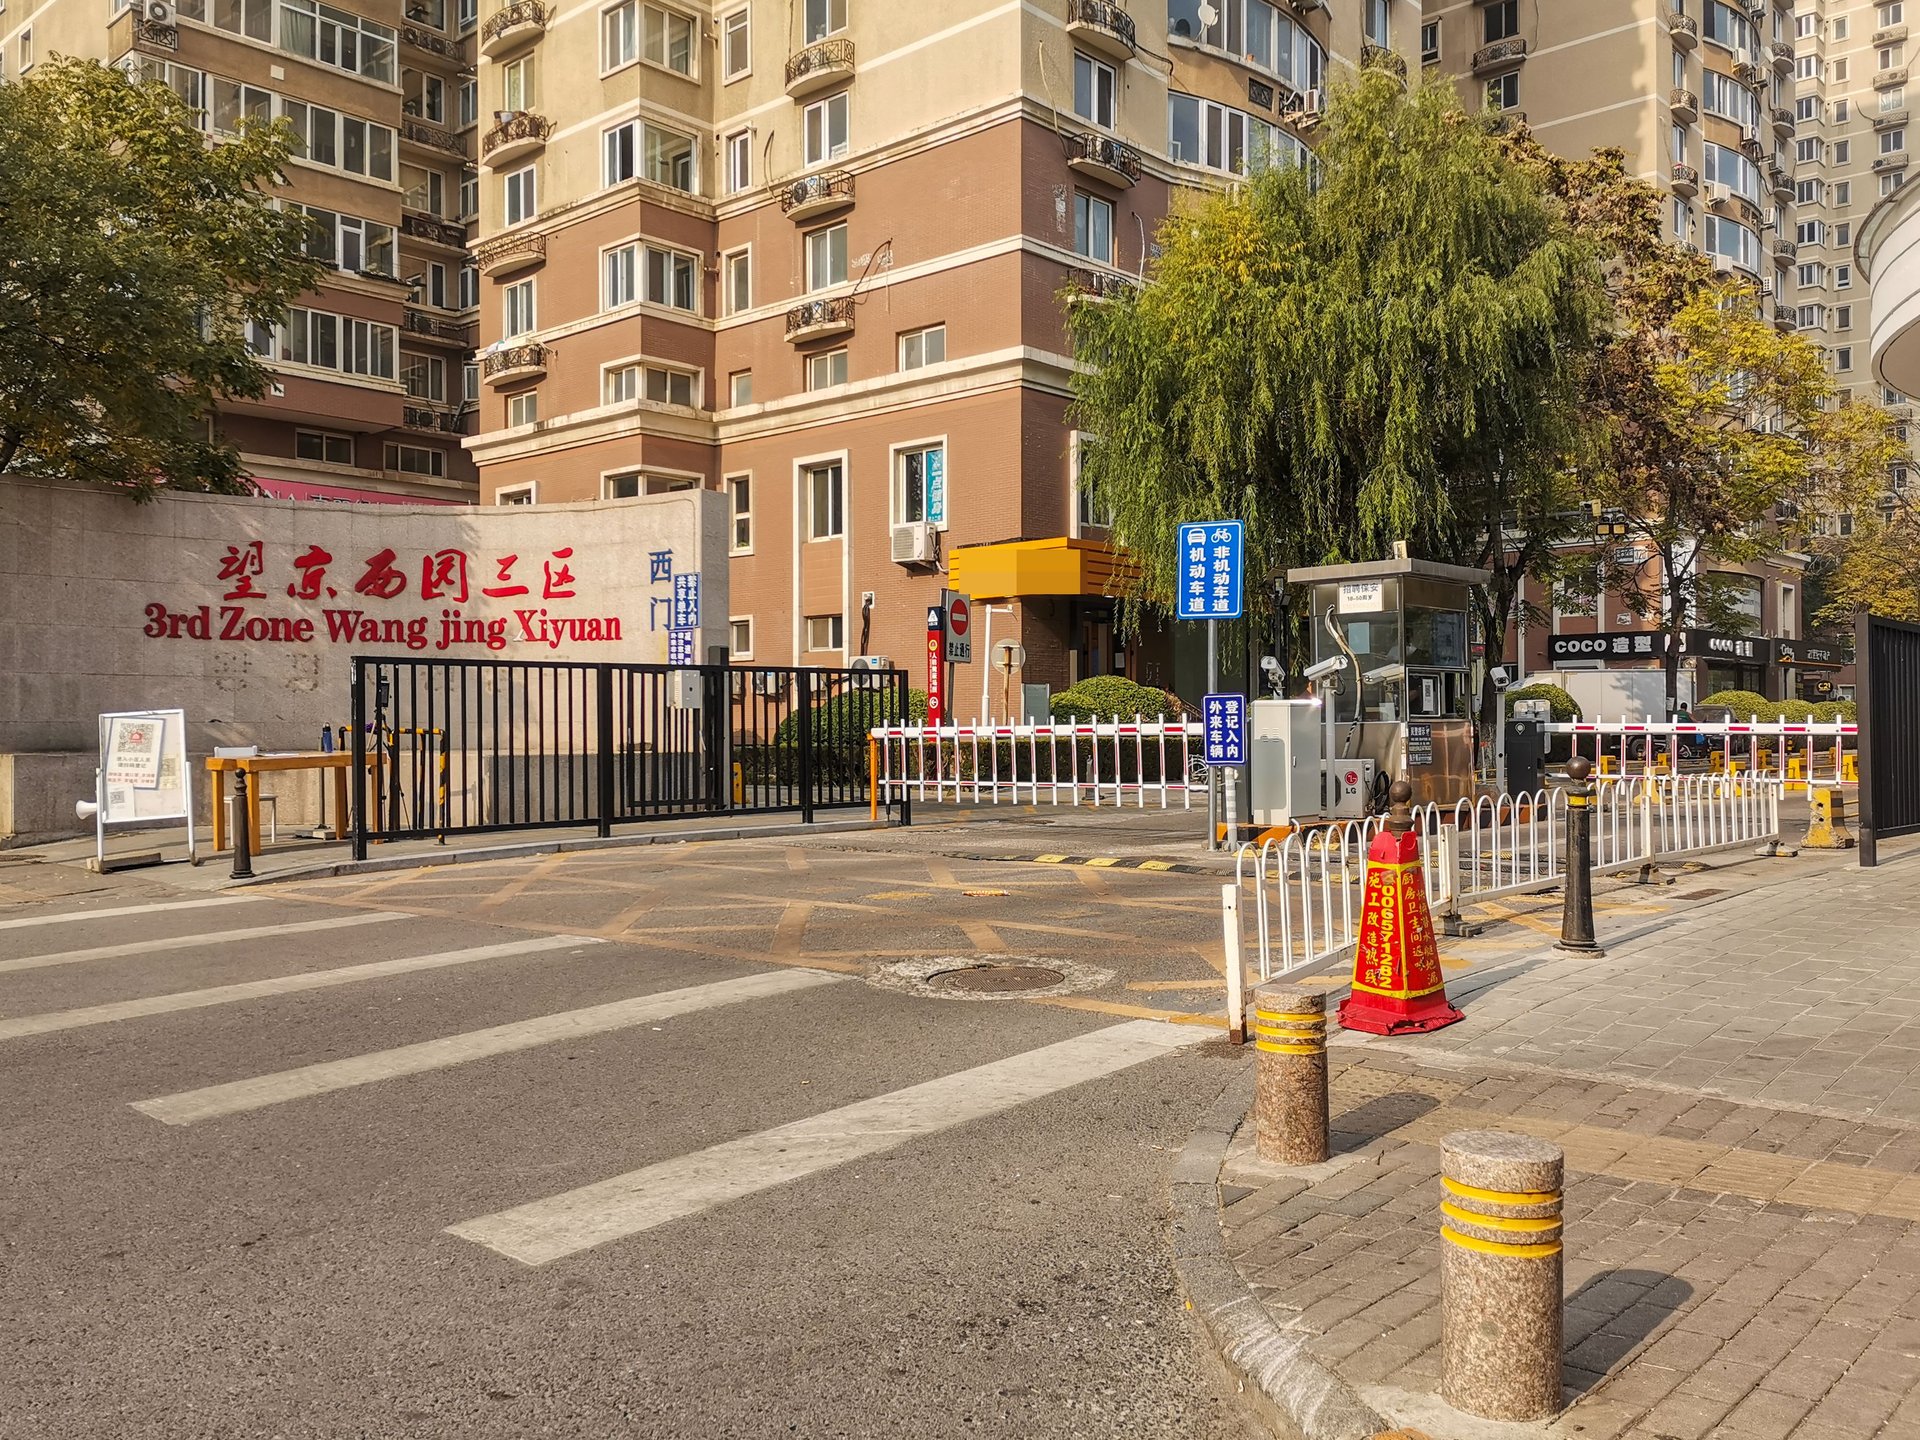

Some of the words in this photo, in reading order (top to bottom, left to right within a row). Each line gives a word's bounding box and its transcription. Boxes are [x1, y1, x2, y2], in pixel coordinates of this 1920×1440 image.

[217, 541, 577, 602] 望京西园三区
[648, 548, 674, 632] 西门
[1188, 547, 1206, 612] 机动车道
[1212, 546, 1231, 612] 非机动车道
[1343, 583, 1378, 594] 招聘保安
[143, 603, 211, 641] 3rd
[219, 606, 314, 642] Zone
[323, 608, 427, 649] Wang
[436, 609, 507, 650] jing
[513, 609, 623, 649] Xiyuan
[949, 642, 970, 658] 禁止通行
[1554, 639, 1607, 654] COCO
[1612, 636, 1652, 653] 造型
[1209, 700, 1223, 758] 外来车辆
[1225, 700, 1239, 758] 登记入内
[1345, 787, 1357, 795] LG
[1365, 873, 1382, 986] 施工改造热线
